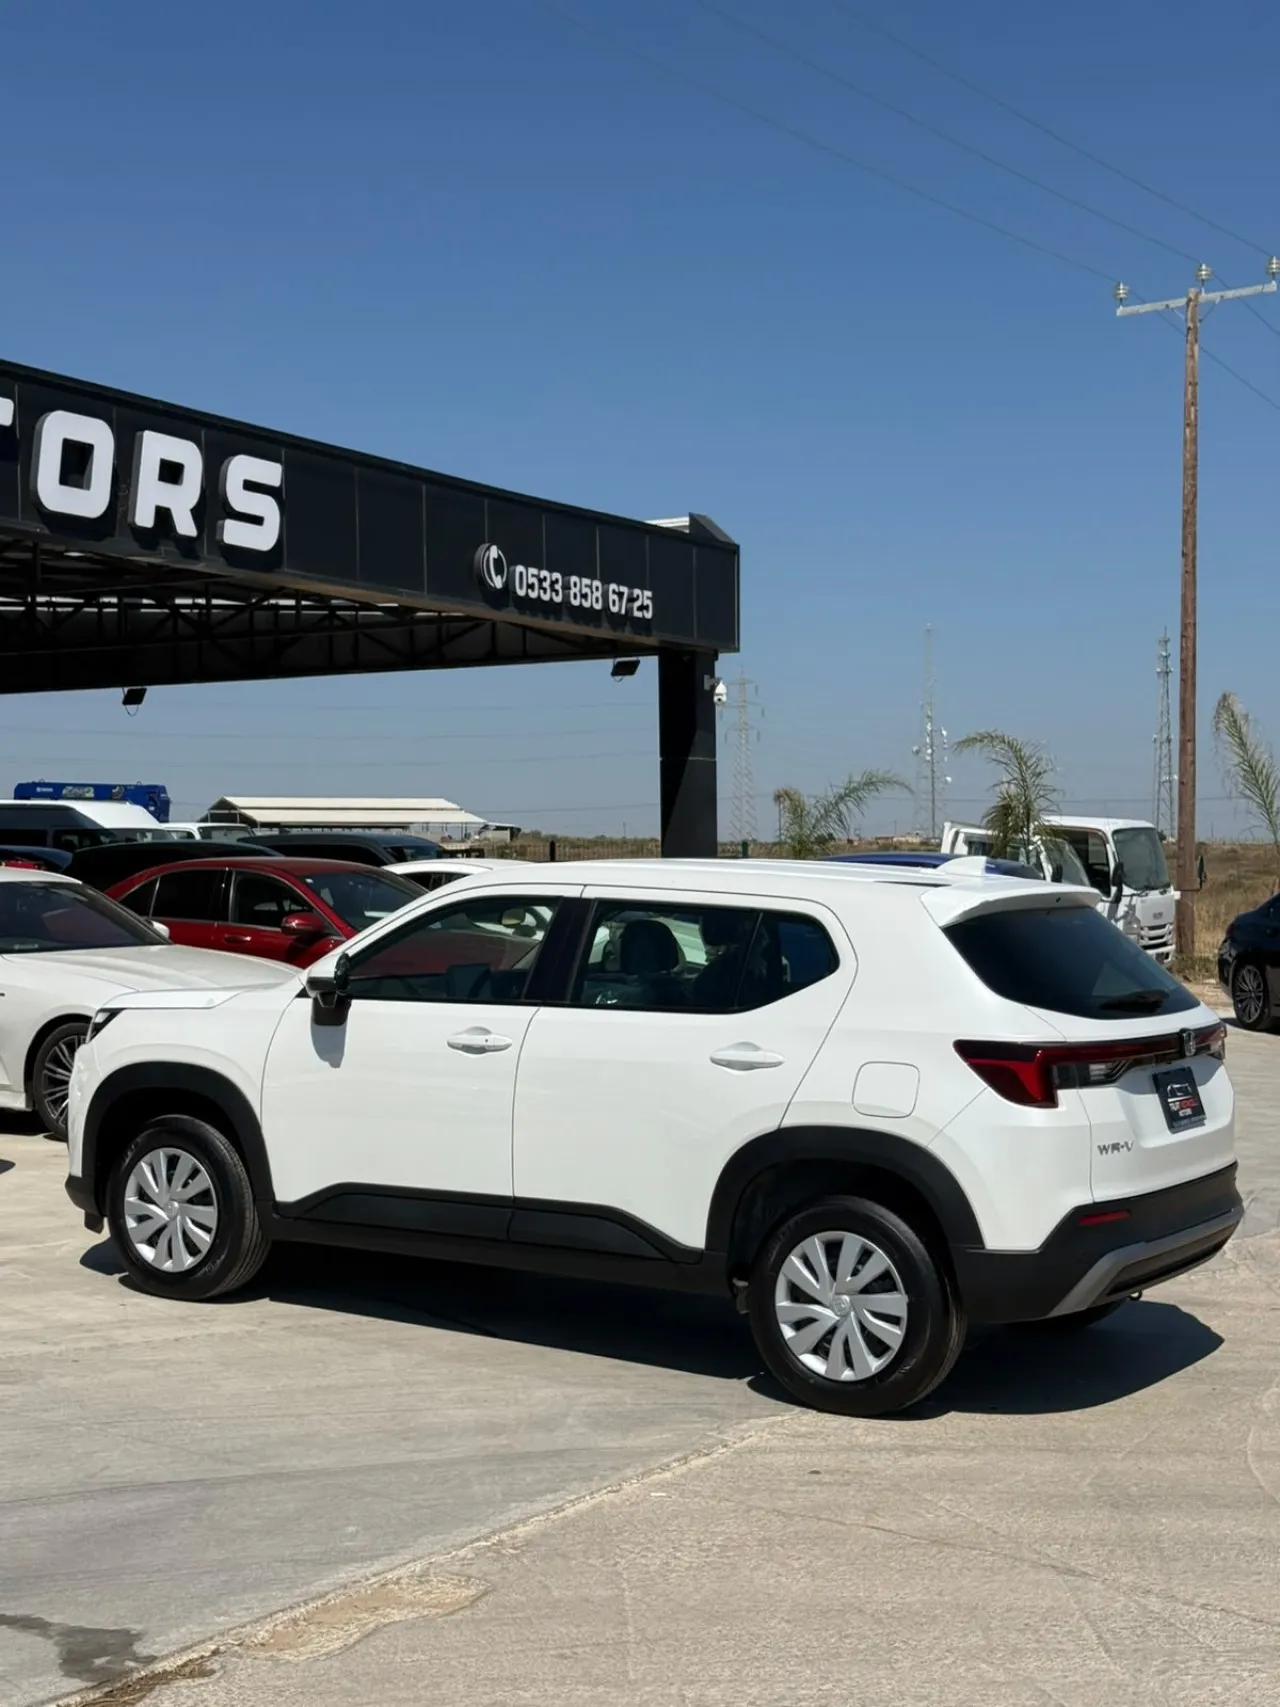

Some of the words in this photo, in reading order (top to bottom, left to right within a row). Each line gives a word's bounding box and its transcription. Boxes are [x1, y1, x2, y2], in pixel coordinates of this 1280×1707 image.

[514, 564, 563, 603] 0533
[569, 575, 602, 610] 858
[608, 582, 628, 615] 67
[633, 588, 653, 619] 25
[1097, 1140, 1134, 1156] WR-V
